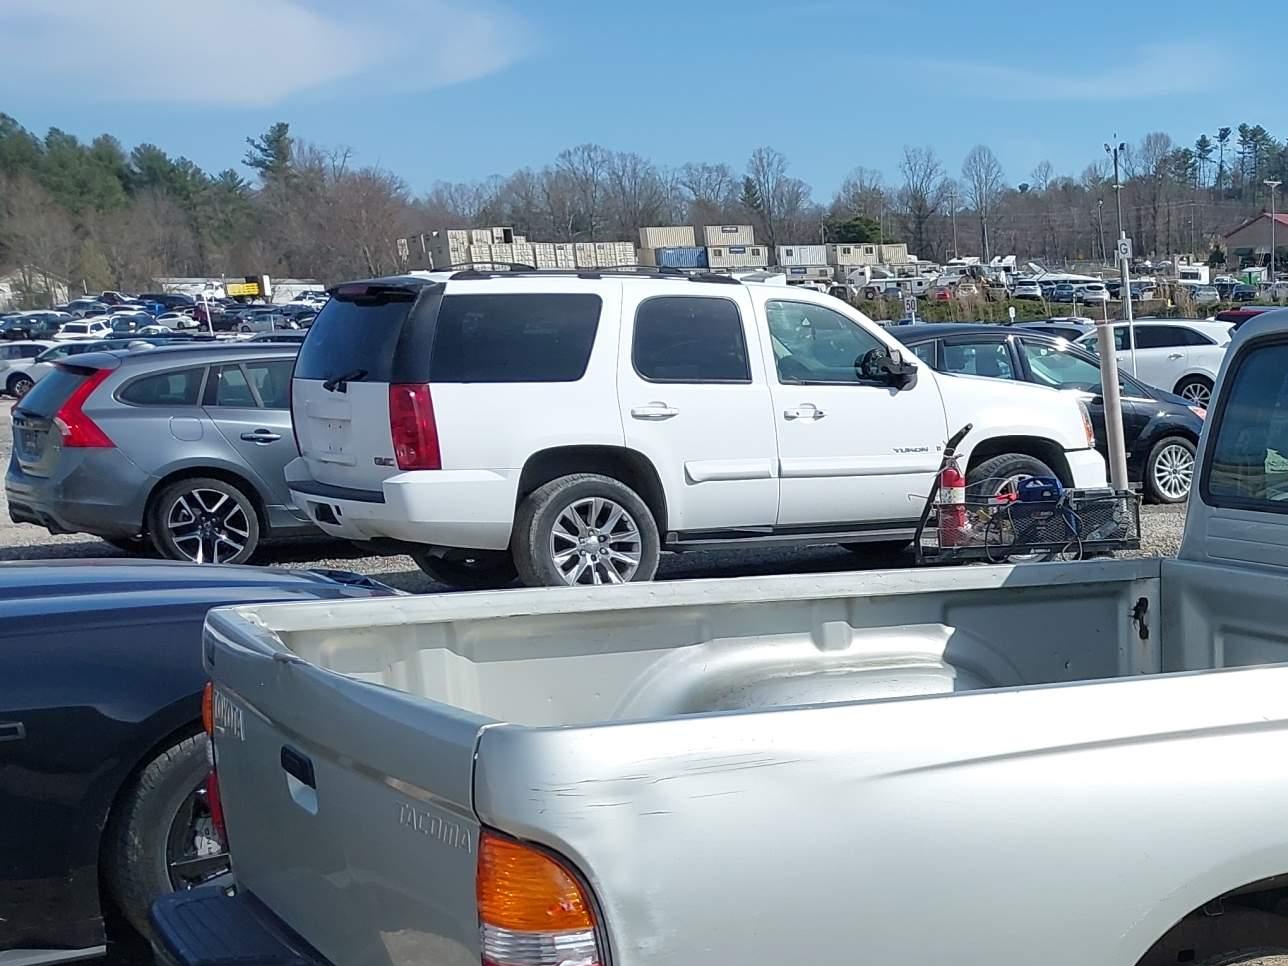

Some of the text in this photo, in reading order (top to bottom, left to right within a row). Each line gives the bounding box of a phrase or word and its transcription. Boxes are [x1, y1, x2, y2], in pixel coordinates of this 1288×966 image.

[1119, 242, 1128, 255] G
[906, 299, 916, 311] 50
[396, 801, 472, 854] TACOMA
